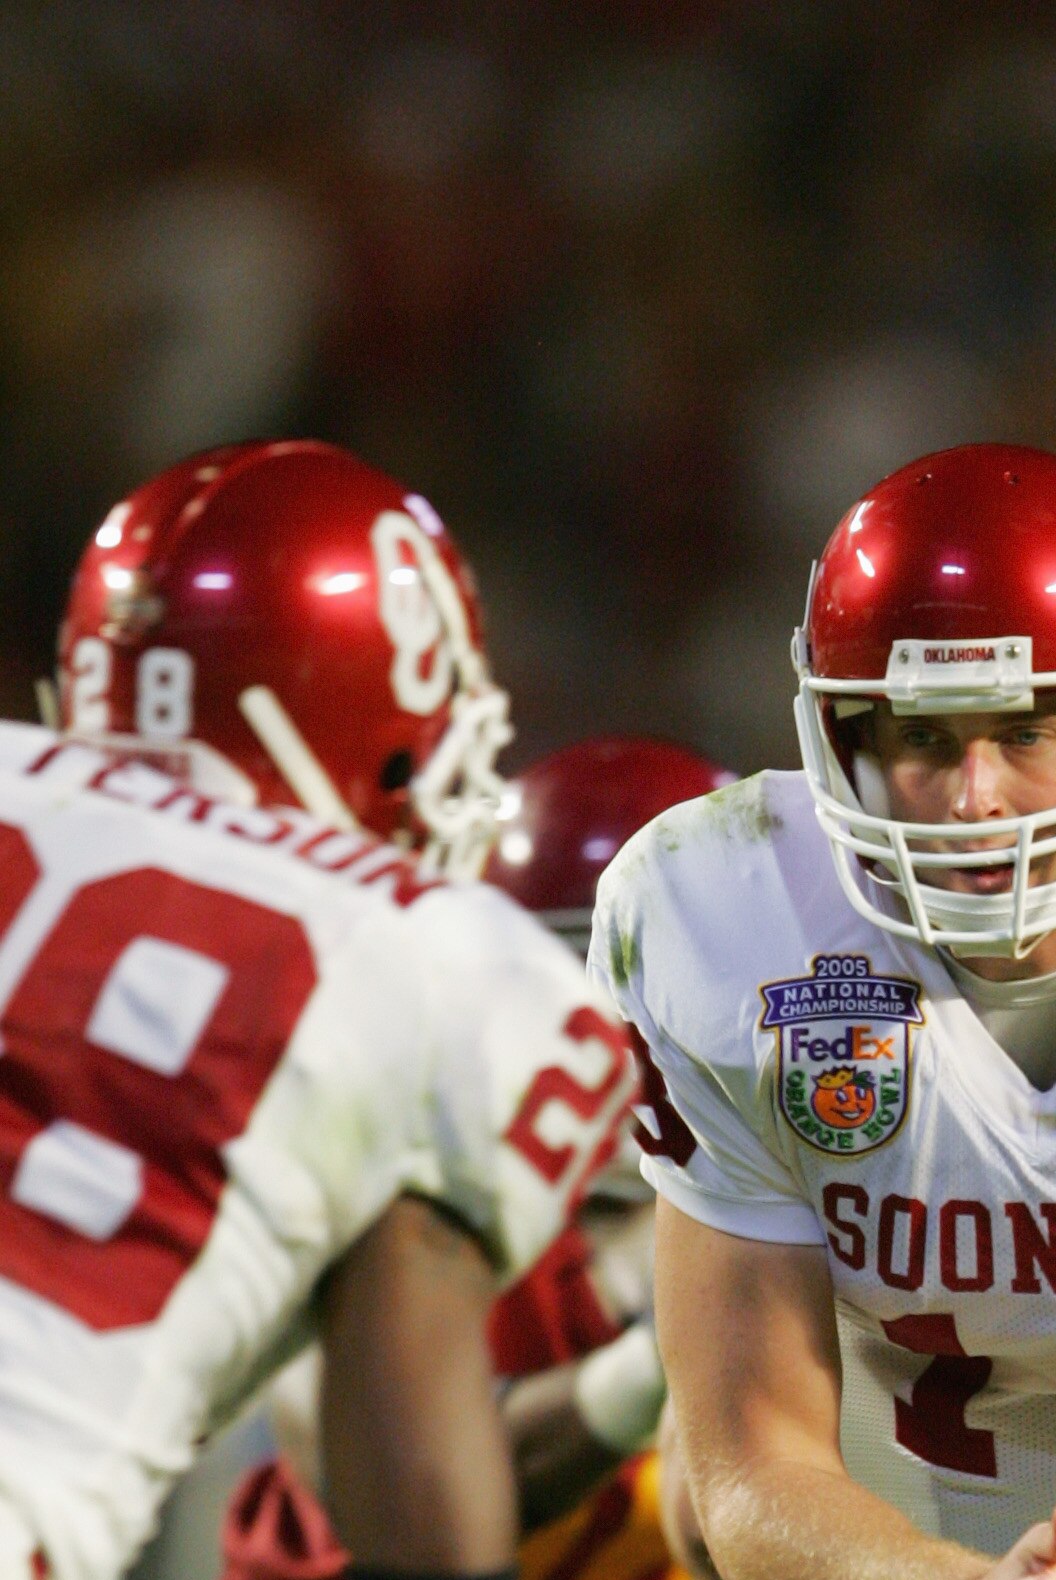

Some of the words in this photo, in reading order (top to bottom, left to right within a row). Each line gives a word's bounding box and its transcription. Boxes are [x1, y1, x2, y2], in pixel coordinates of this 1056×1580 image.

[924, 646, 996, 664] OKLAHOMA
[72, 634, 196, 738] 28
[817, 959, 867, 977] 2005
[783, 982, 900, 1003] NATIONAL
[779, 998, 906, 1018] CHAMPIONSHIP
[789, 1025, 895, 1063] FedEx
[786, 1069, 854, 1149] ORANGE
[862, 1068, 901, 1141] BOWL
